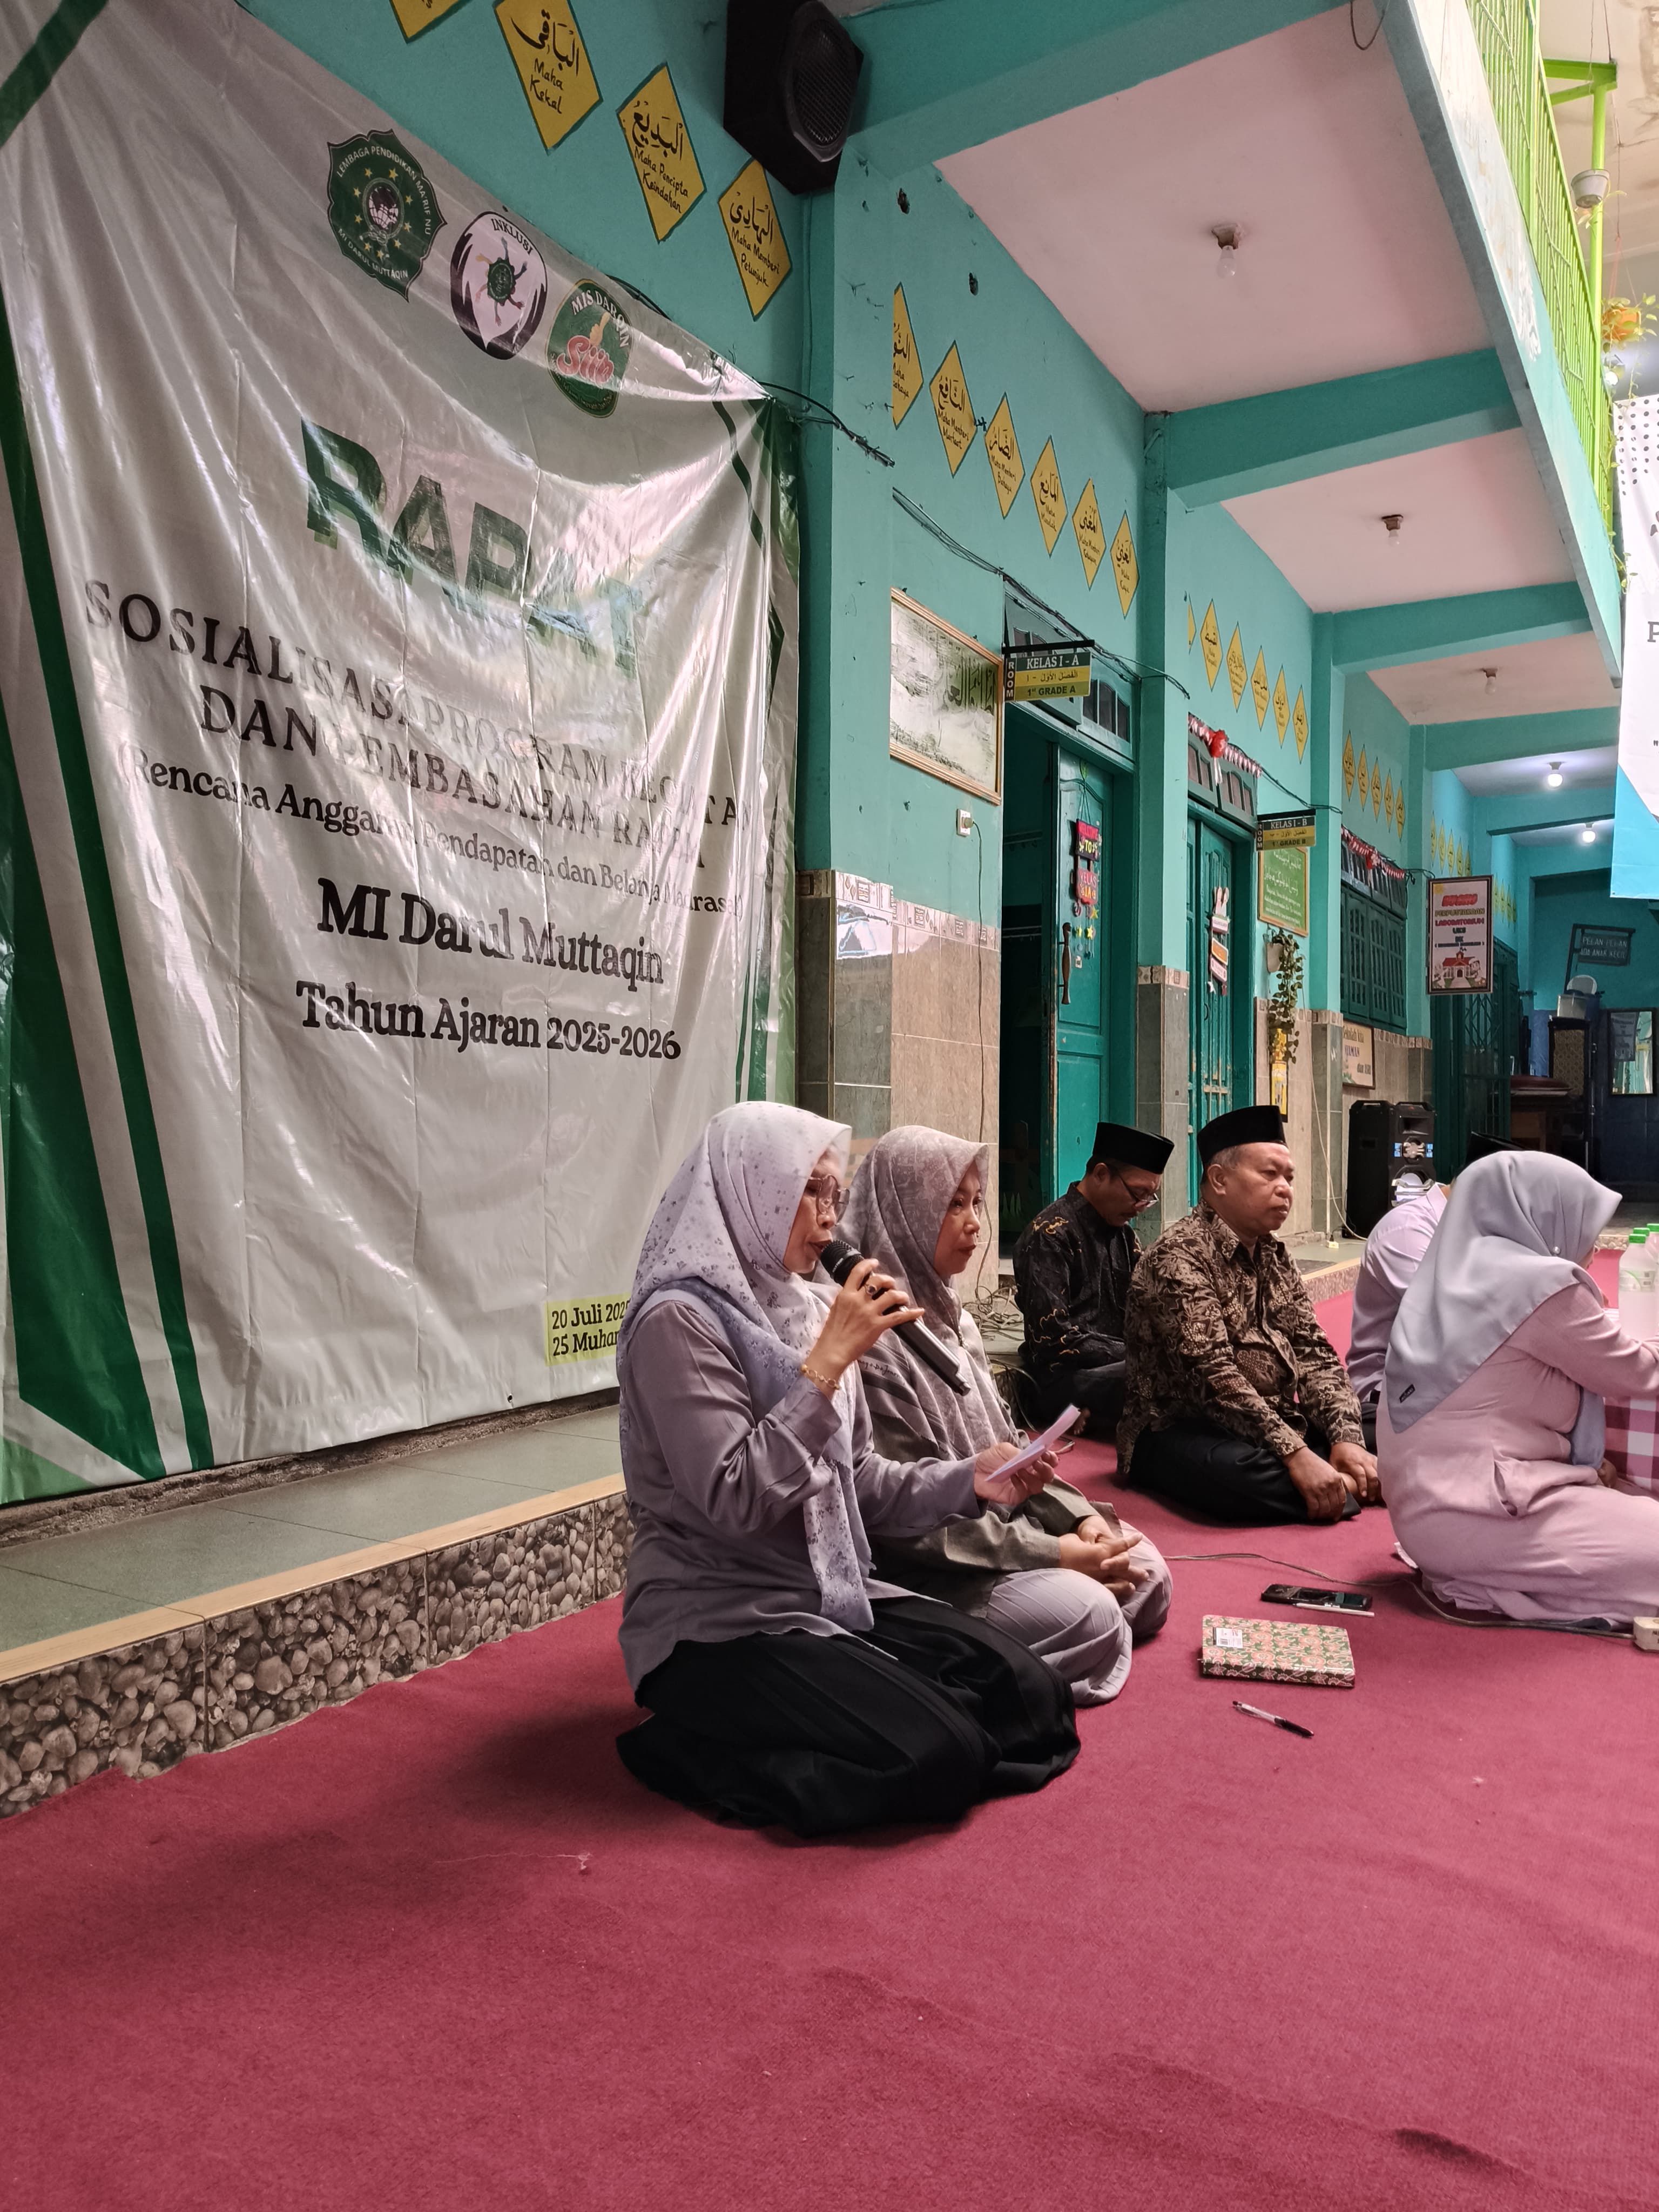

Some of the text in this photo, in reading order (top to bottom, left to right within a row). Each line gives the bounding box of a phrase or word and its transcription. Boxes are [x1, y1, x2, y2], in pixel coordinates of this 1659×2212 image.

[534, 57, 563, 91] Maha
[530, 75, 562, 114] Kekal
[336, 146, 431, 235] LEMBAGA PENDIDIKAN MA'RIF NU
[635, 146, 689, 197] Maha Pencipta
[643, 170, 682, 213] Keindahan
[338, 228, 409, 280] MI DARUL MUTTAQIN
[490, 218, 534, 255] INKLUSI
[731, 227, 780, 274] Maha Memberi
[741, 253, 769, 287] Petunjuk
[571, 290, 594, 315] MIS
[85, 579, 414, 727] SOSIALISASI
[1027, 657, 1057, 669] KELAS
[1059, 656, 1063, 666] I
[1071, 655, 1079, 665] A
[1006, 662, 1014, 697] ROOM
[1038, 686, 1068, 696] GRADE
[1070, 685, 1076, 693] A
[200, 684, 318, 756] DAN
[118, 743, 271, 811] Rencana
[275, 784, 418, 845] Anggaran
[422, 821, 555, 878] Pendapatan
[557, 855, 597, 887] dan
[598, 864, 660, 906] Belanja
[1271, 820, 1292, 830] KELAS
[1080, 871, 1097, 887] KELAS
[317, 877, 664, 992] MI Darul Muttaqin
[296, 980, 682, 1060] Tahun Ajaran 2025-2026
[552, 1310, 567, 1330] 20
[571, 1304, 602, 1327] Juli
[553, 1329, 619, 1356] 25 Muhar
